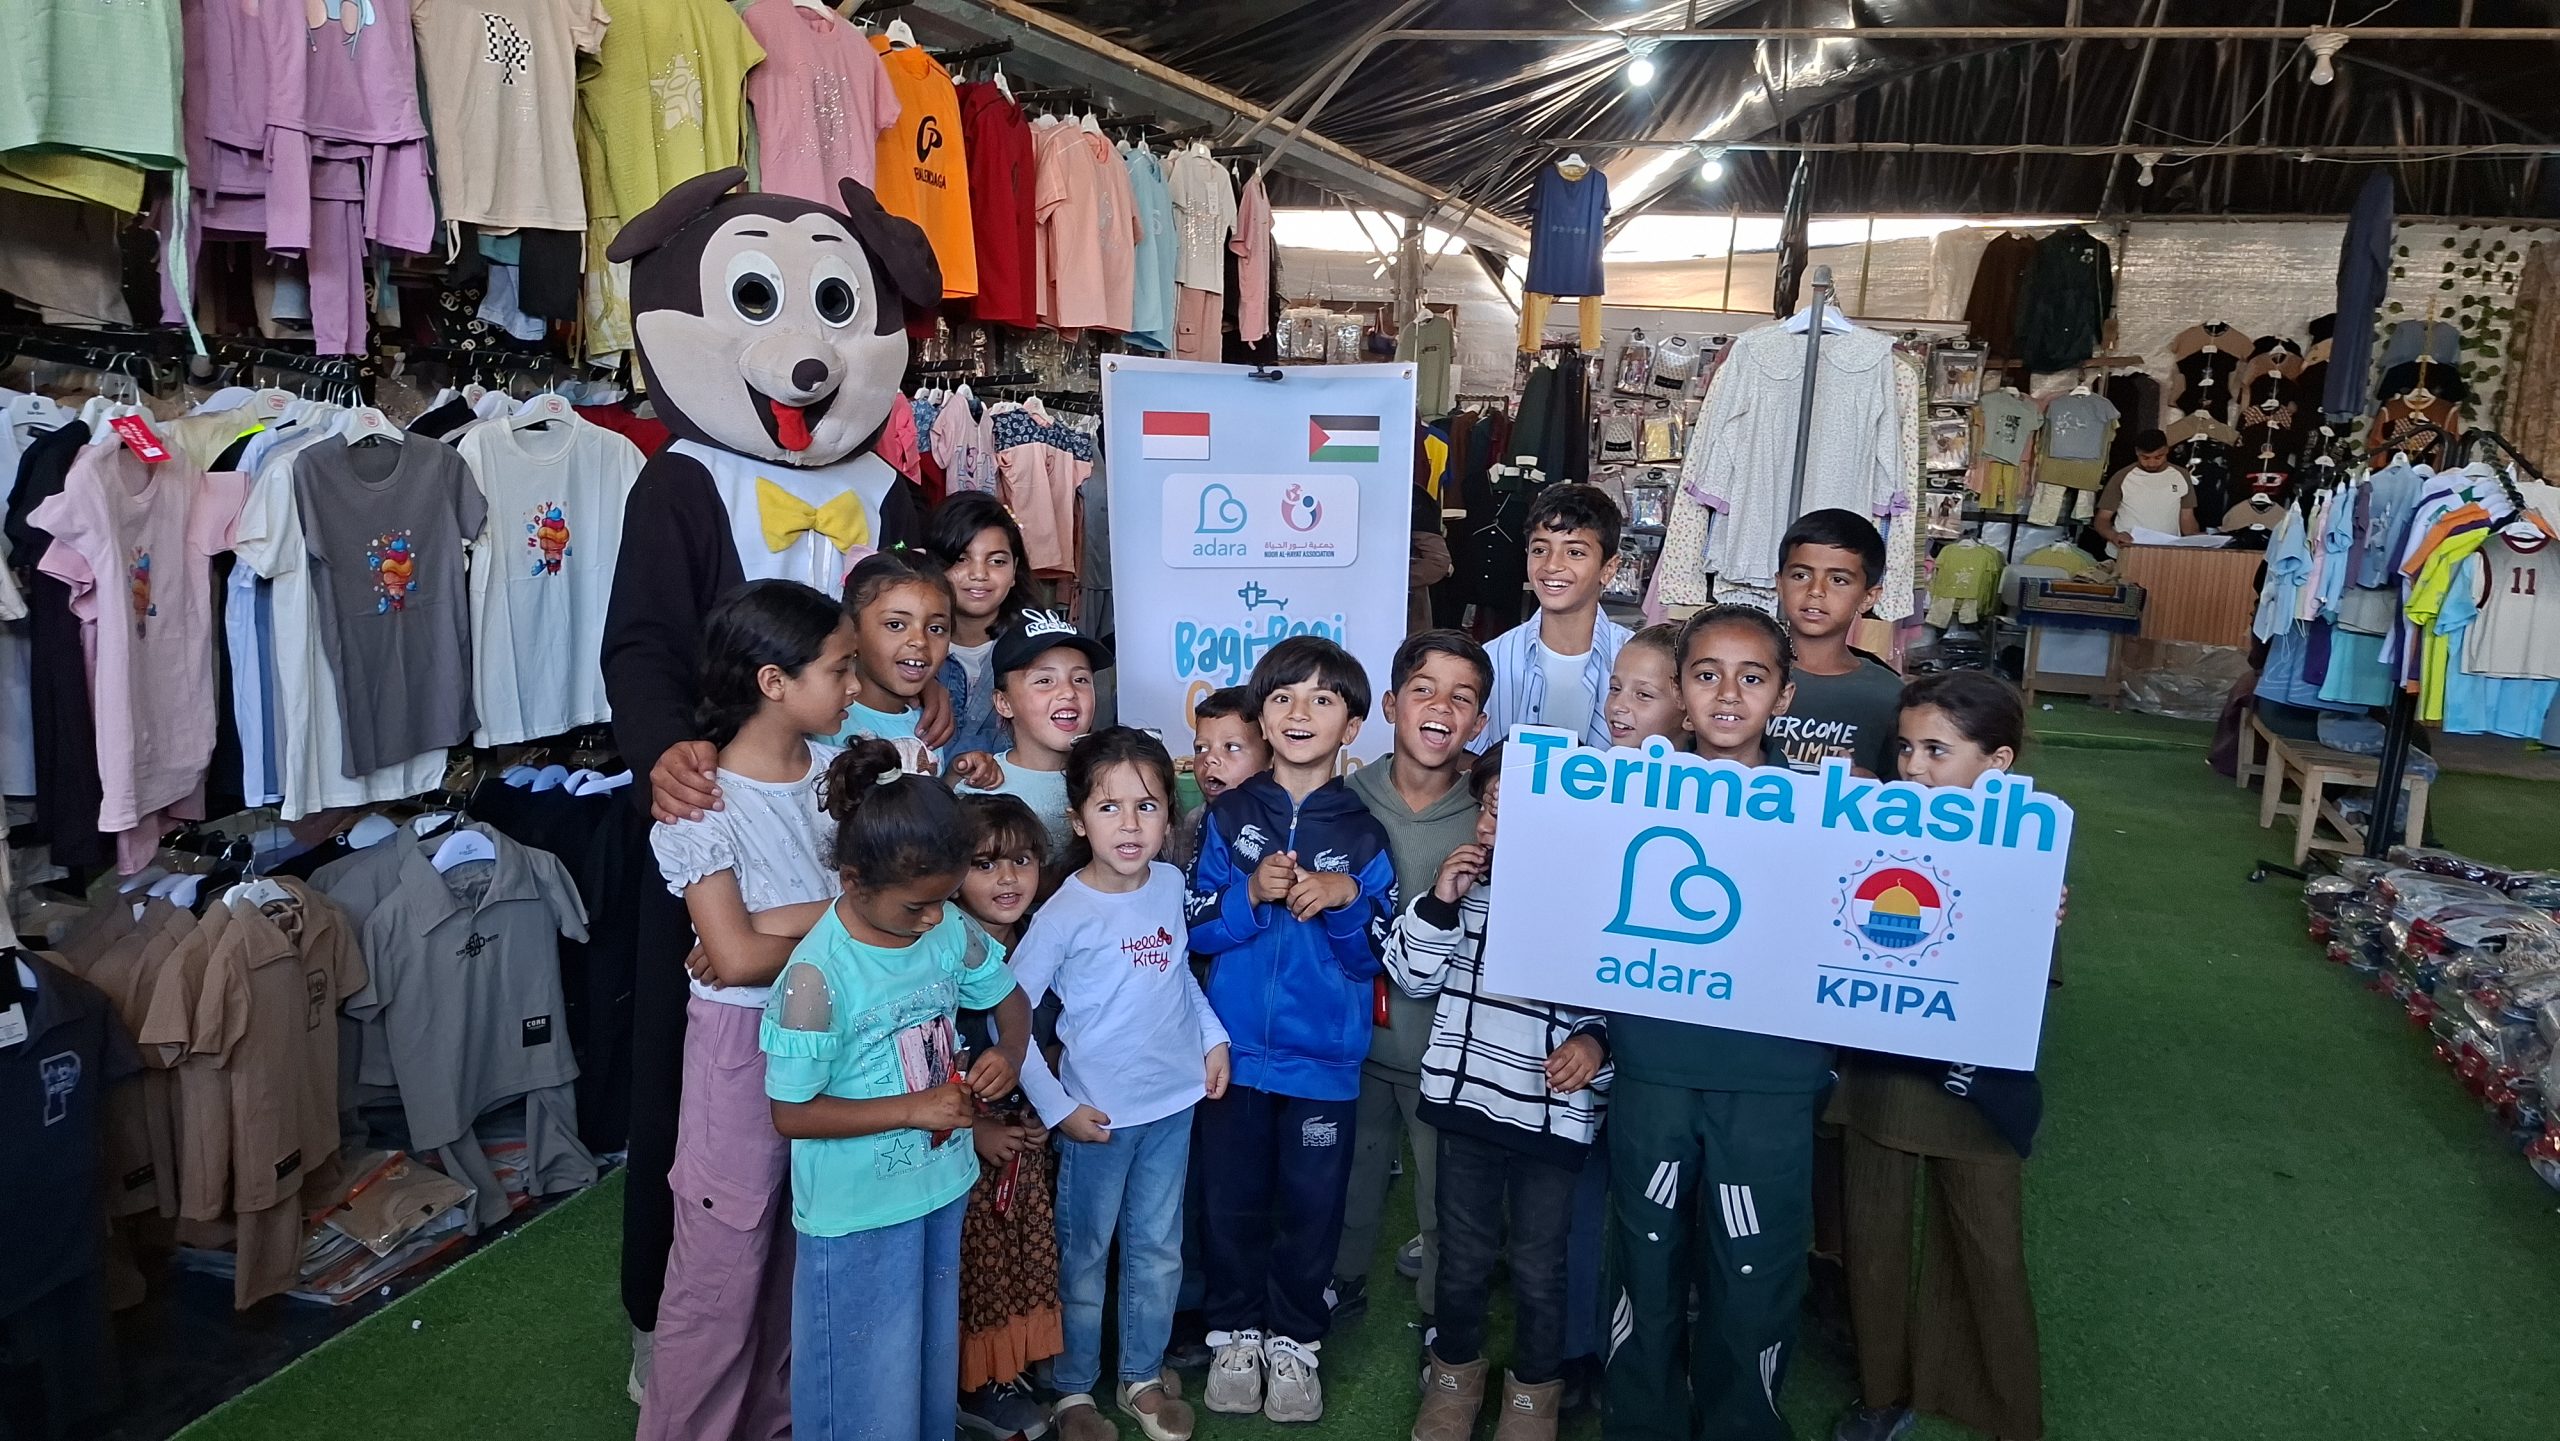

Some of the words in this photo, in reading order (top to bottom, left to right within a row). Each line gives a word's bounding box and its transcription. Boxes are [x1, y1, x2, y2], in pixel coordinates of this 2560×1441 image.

[1192, 537, 1247, 556] adara
[2511, 566, 2535, 595] 11
[1765, 716, 1858, 745] VERCOME
[1783, 740, 1855, 764] LIMIT
[1519, 732, 1796, 823] Terima
[1822, 765, 2057, 852] kasih
[1120, 935, 1164, 954] Hello
[1133, 950, 1171, 972] Kitty
[1596, 948, 1733, 1000] adara
[1816, 976, 1957, 1022] KPIPA
